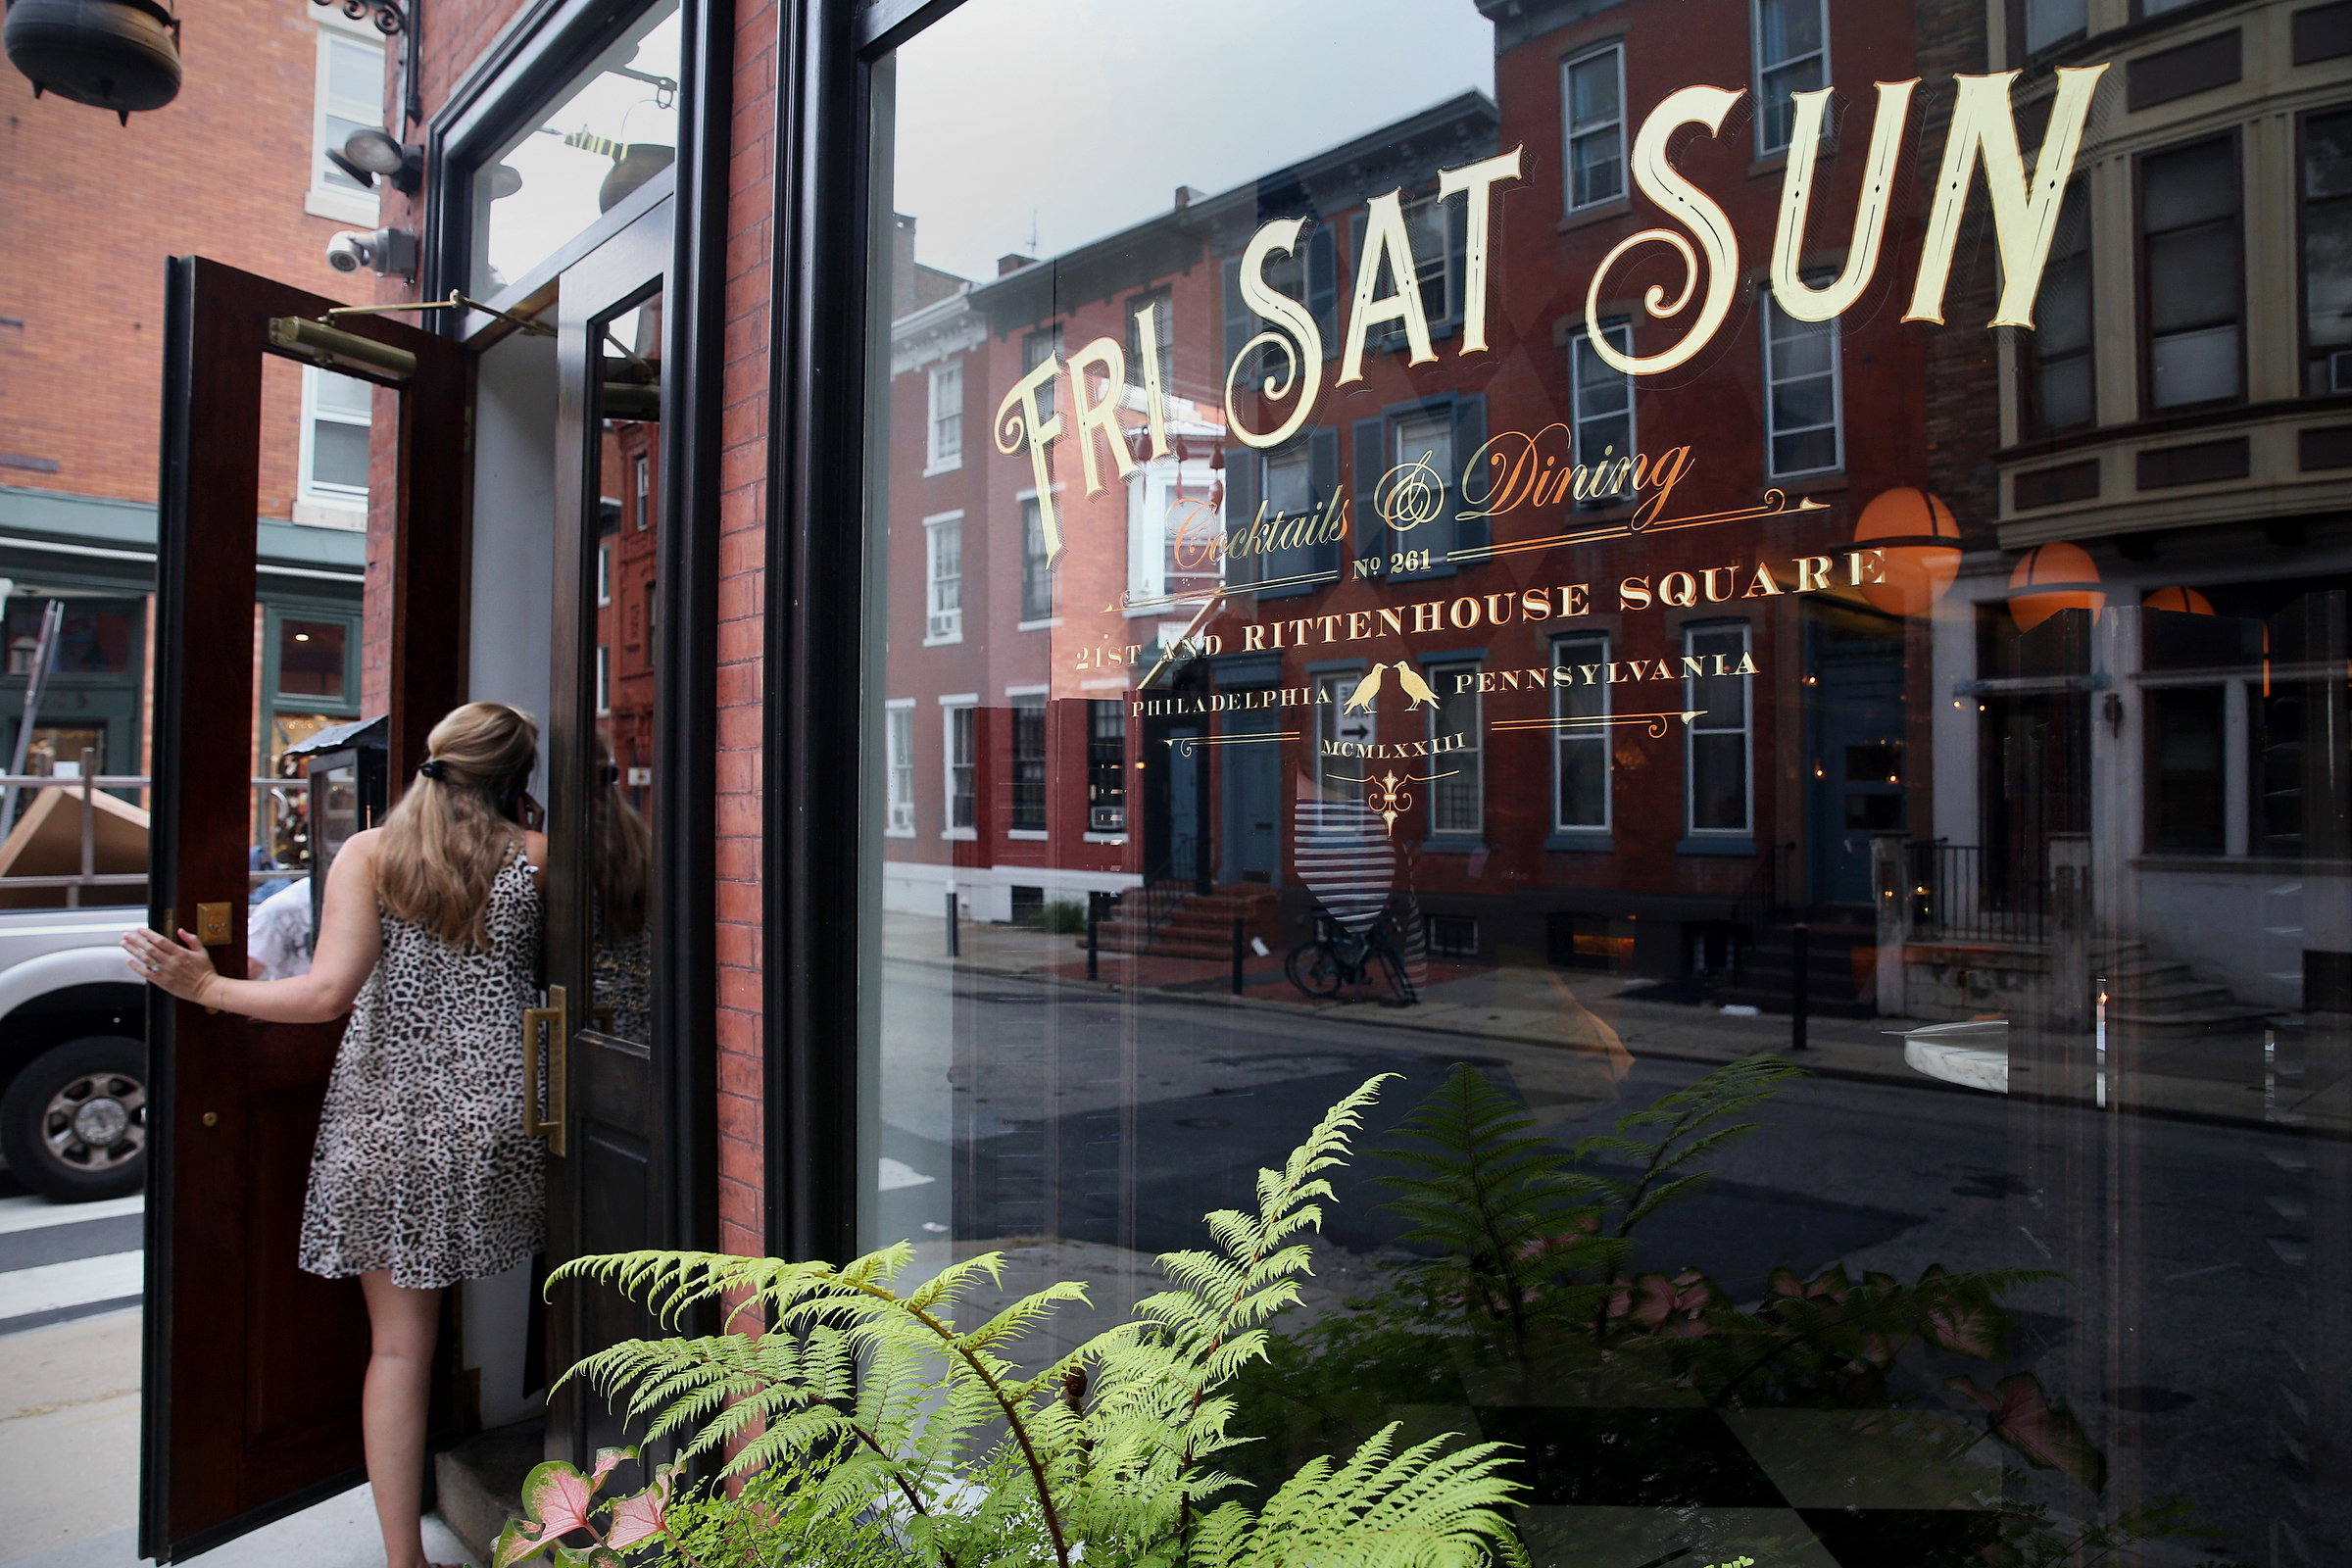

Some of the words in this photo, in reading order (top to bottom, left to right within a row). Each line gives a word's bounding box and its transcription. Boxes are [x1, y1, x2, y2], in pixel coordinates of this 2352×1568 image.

[994, 302, 1171, 570] FRI
[1225, 143, 1524, 449] SAT
[1585, 62, 2111, 376] SUN
[1165, 484, 1350, 569] Cocktails
[1373, 449, 1445, 532] &
[1455, 422, 1695, 531] Dining
[1390, 548, 1432, 574] 261
[1075, 644, 1142, 670] 21ST
[1159, 634, 1223, 662] AND
[1242, 583, 1591, 654] RITTENHOUSE
[1618, 548, 1887, 614] SQUARE
[1132, 685, 1333, 718] PHILADELPHIA
[1453, 651, 1760, 695] PENNSYLVANIA
[1320, 732, 1466, 760] MCMLXXIII
